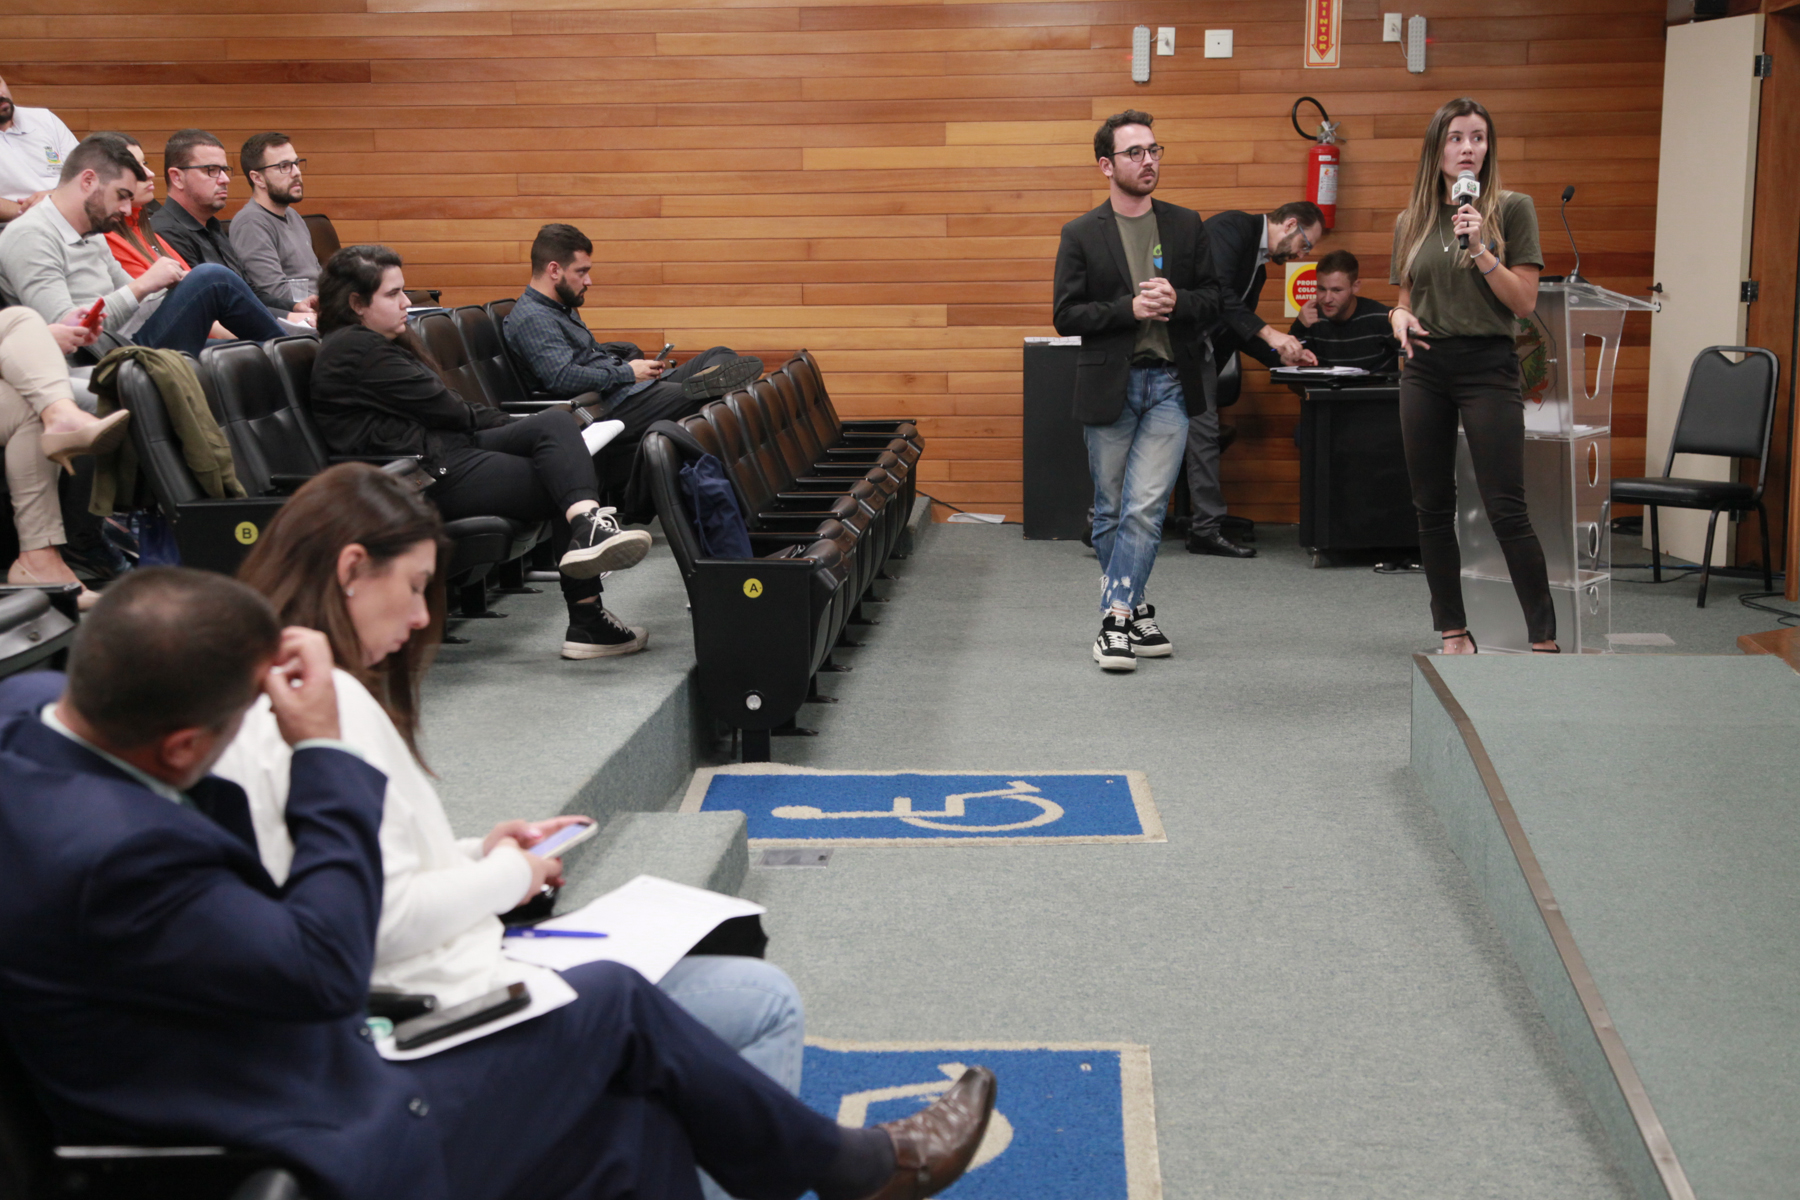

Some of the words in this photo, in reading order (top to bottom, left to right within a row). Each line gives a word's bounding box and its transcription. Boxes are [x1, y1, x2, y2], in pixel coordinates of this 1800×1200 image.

[1319, 1, 1328, 50] TINTOR
[242, 528, 252, 539] B
[749, 583, 759, 593] A
